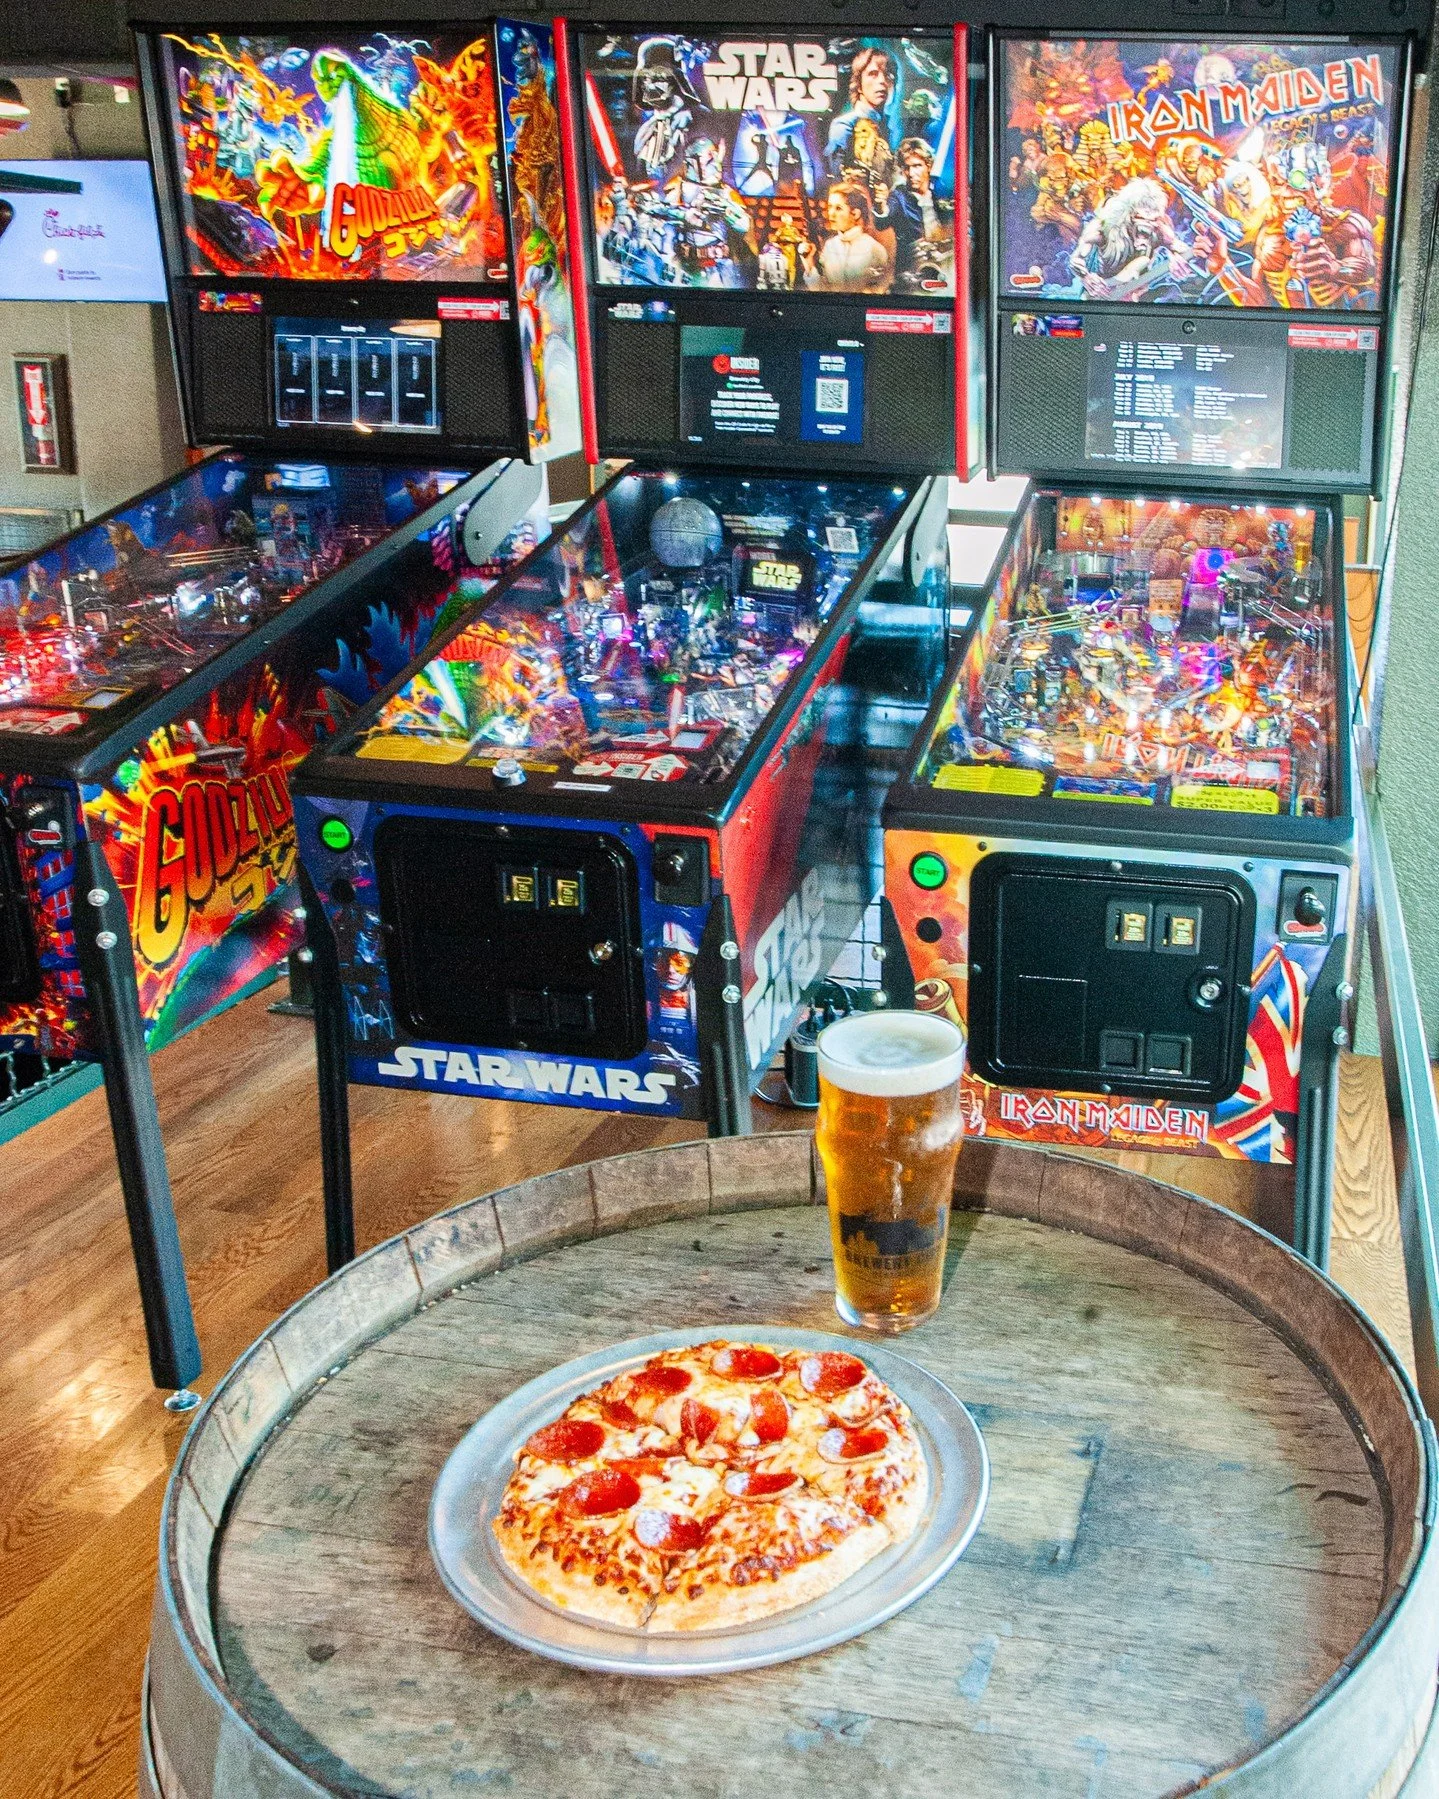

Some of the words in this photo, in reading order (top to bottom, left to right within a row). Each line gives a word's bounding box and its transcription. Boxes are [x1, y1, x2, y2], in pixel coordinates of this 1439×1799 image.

[703, 42, 838, 78] STAR
[704, 76, 838, 112] WARS
[1107, 87, 1214, 149] IRON
[1217, 54, 1384, 128] MAIDEN
[1330, 103, 1374, 122] BEAST
[330, 182, 441, 257] GODZILLA
[752, 561, 802, 577] STAR
[752, 573, 802, 590] WARS
[378, 1046, 524, 1090] STAR
[524, 1059, 677, 1105] WARS
[1001, 1092, 1079, 1134] IRON
[1085, 1100, 1209, 1145] MAIDEN
